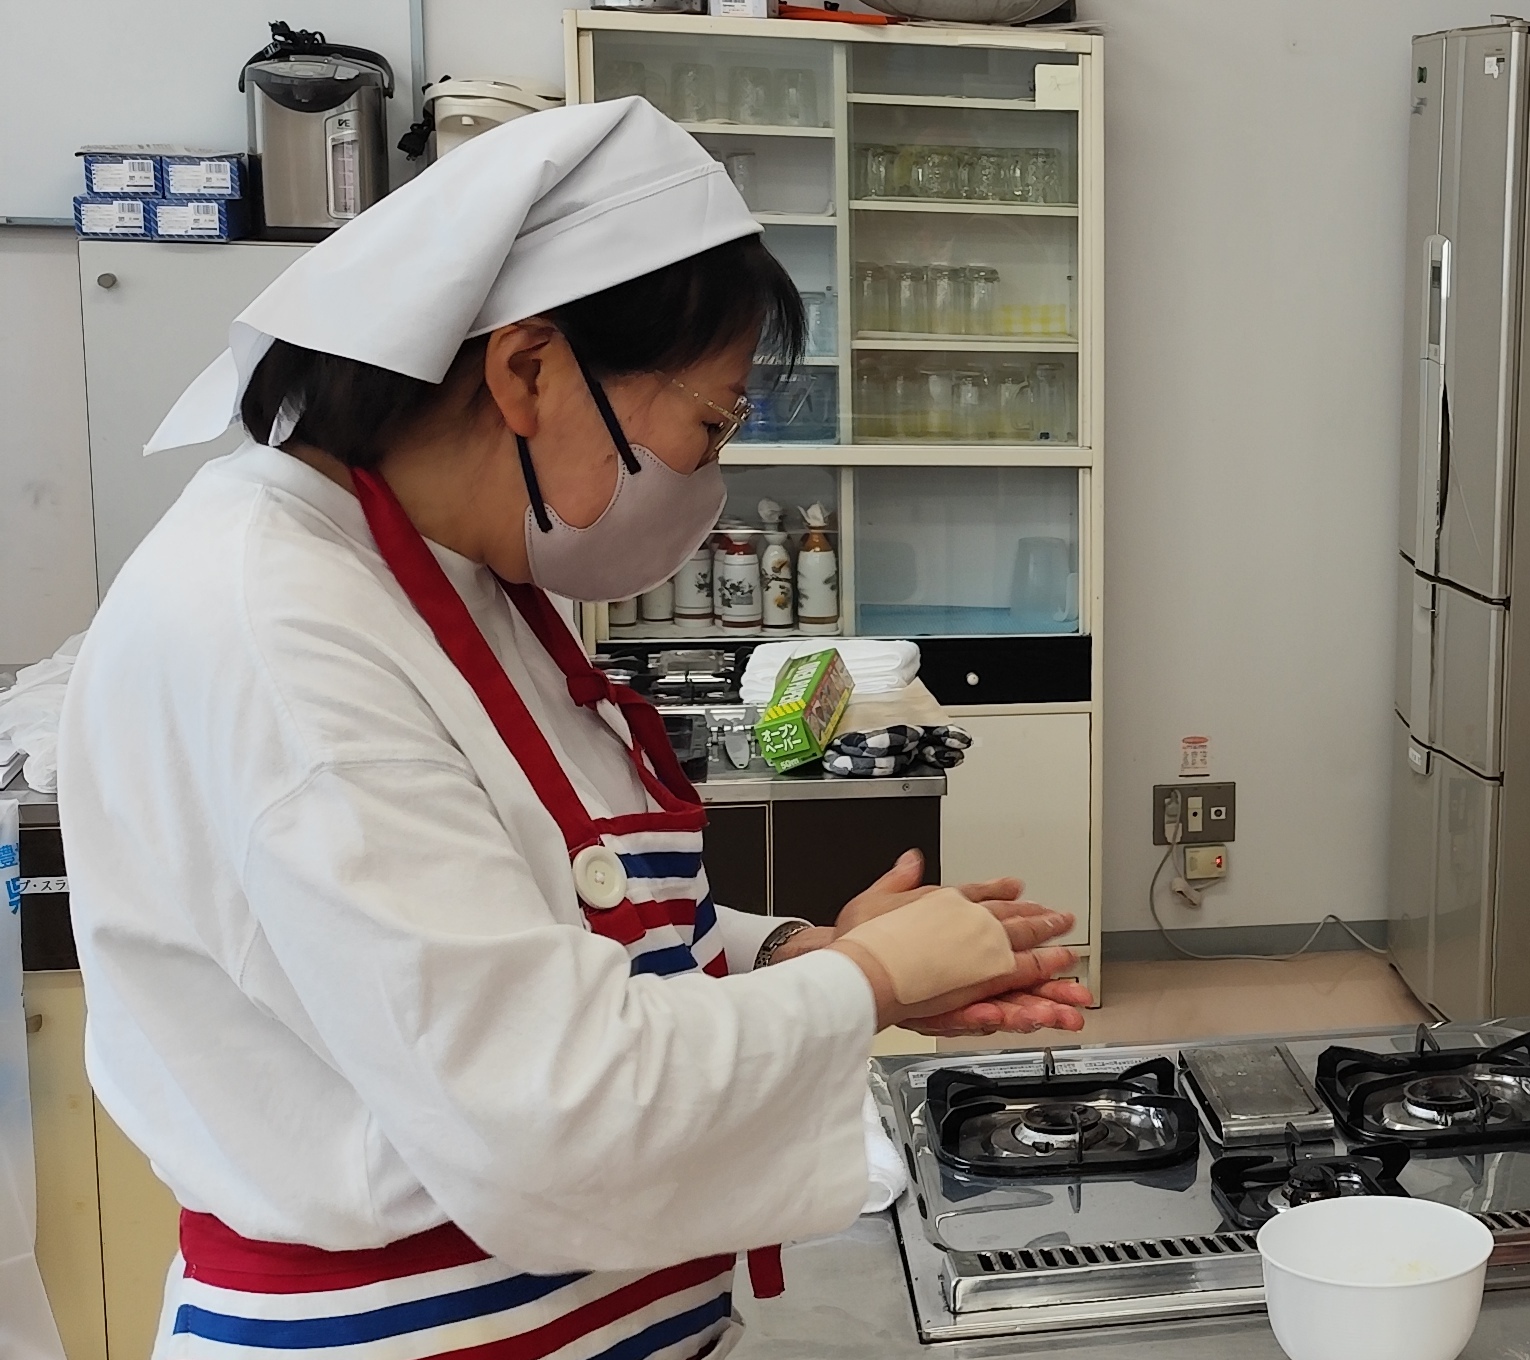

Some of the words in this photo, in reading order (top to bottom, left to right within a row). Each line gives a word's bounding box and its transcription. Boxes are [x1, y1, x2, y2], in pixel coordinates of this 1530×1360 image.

[761, 723, 798, 742] オープン
[765, 736, 802, 753] ペーパー
[780, 758, 800, 771] 50m
